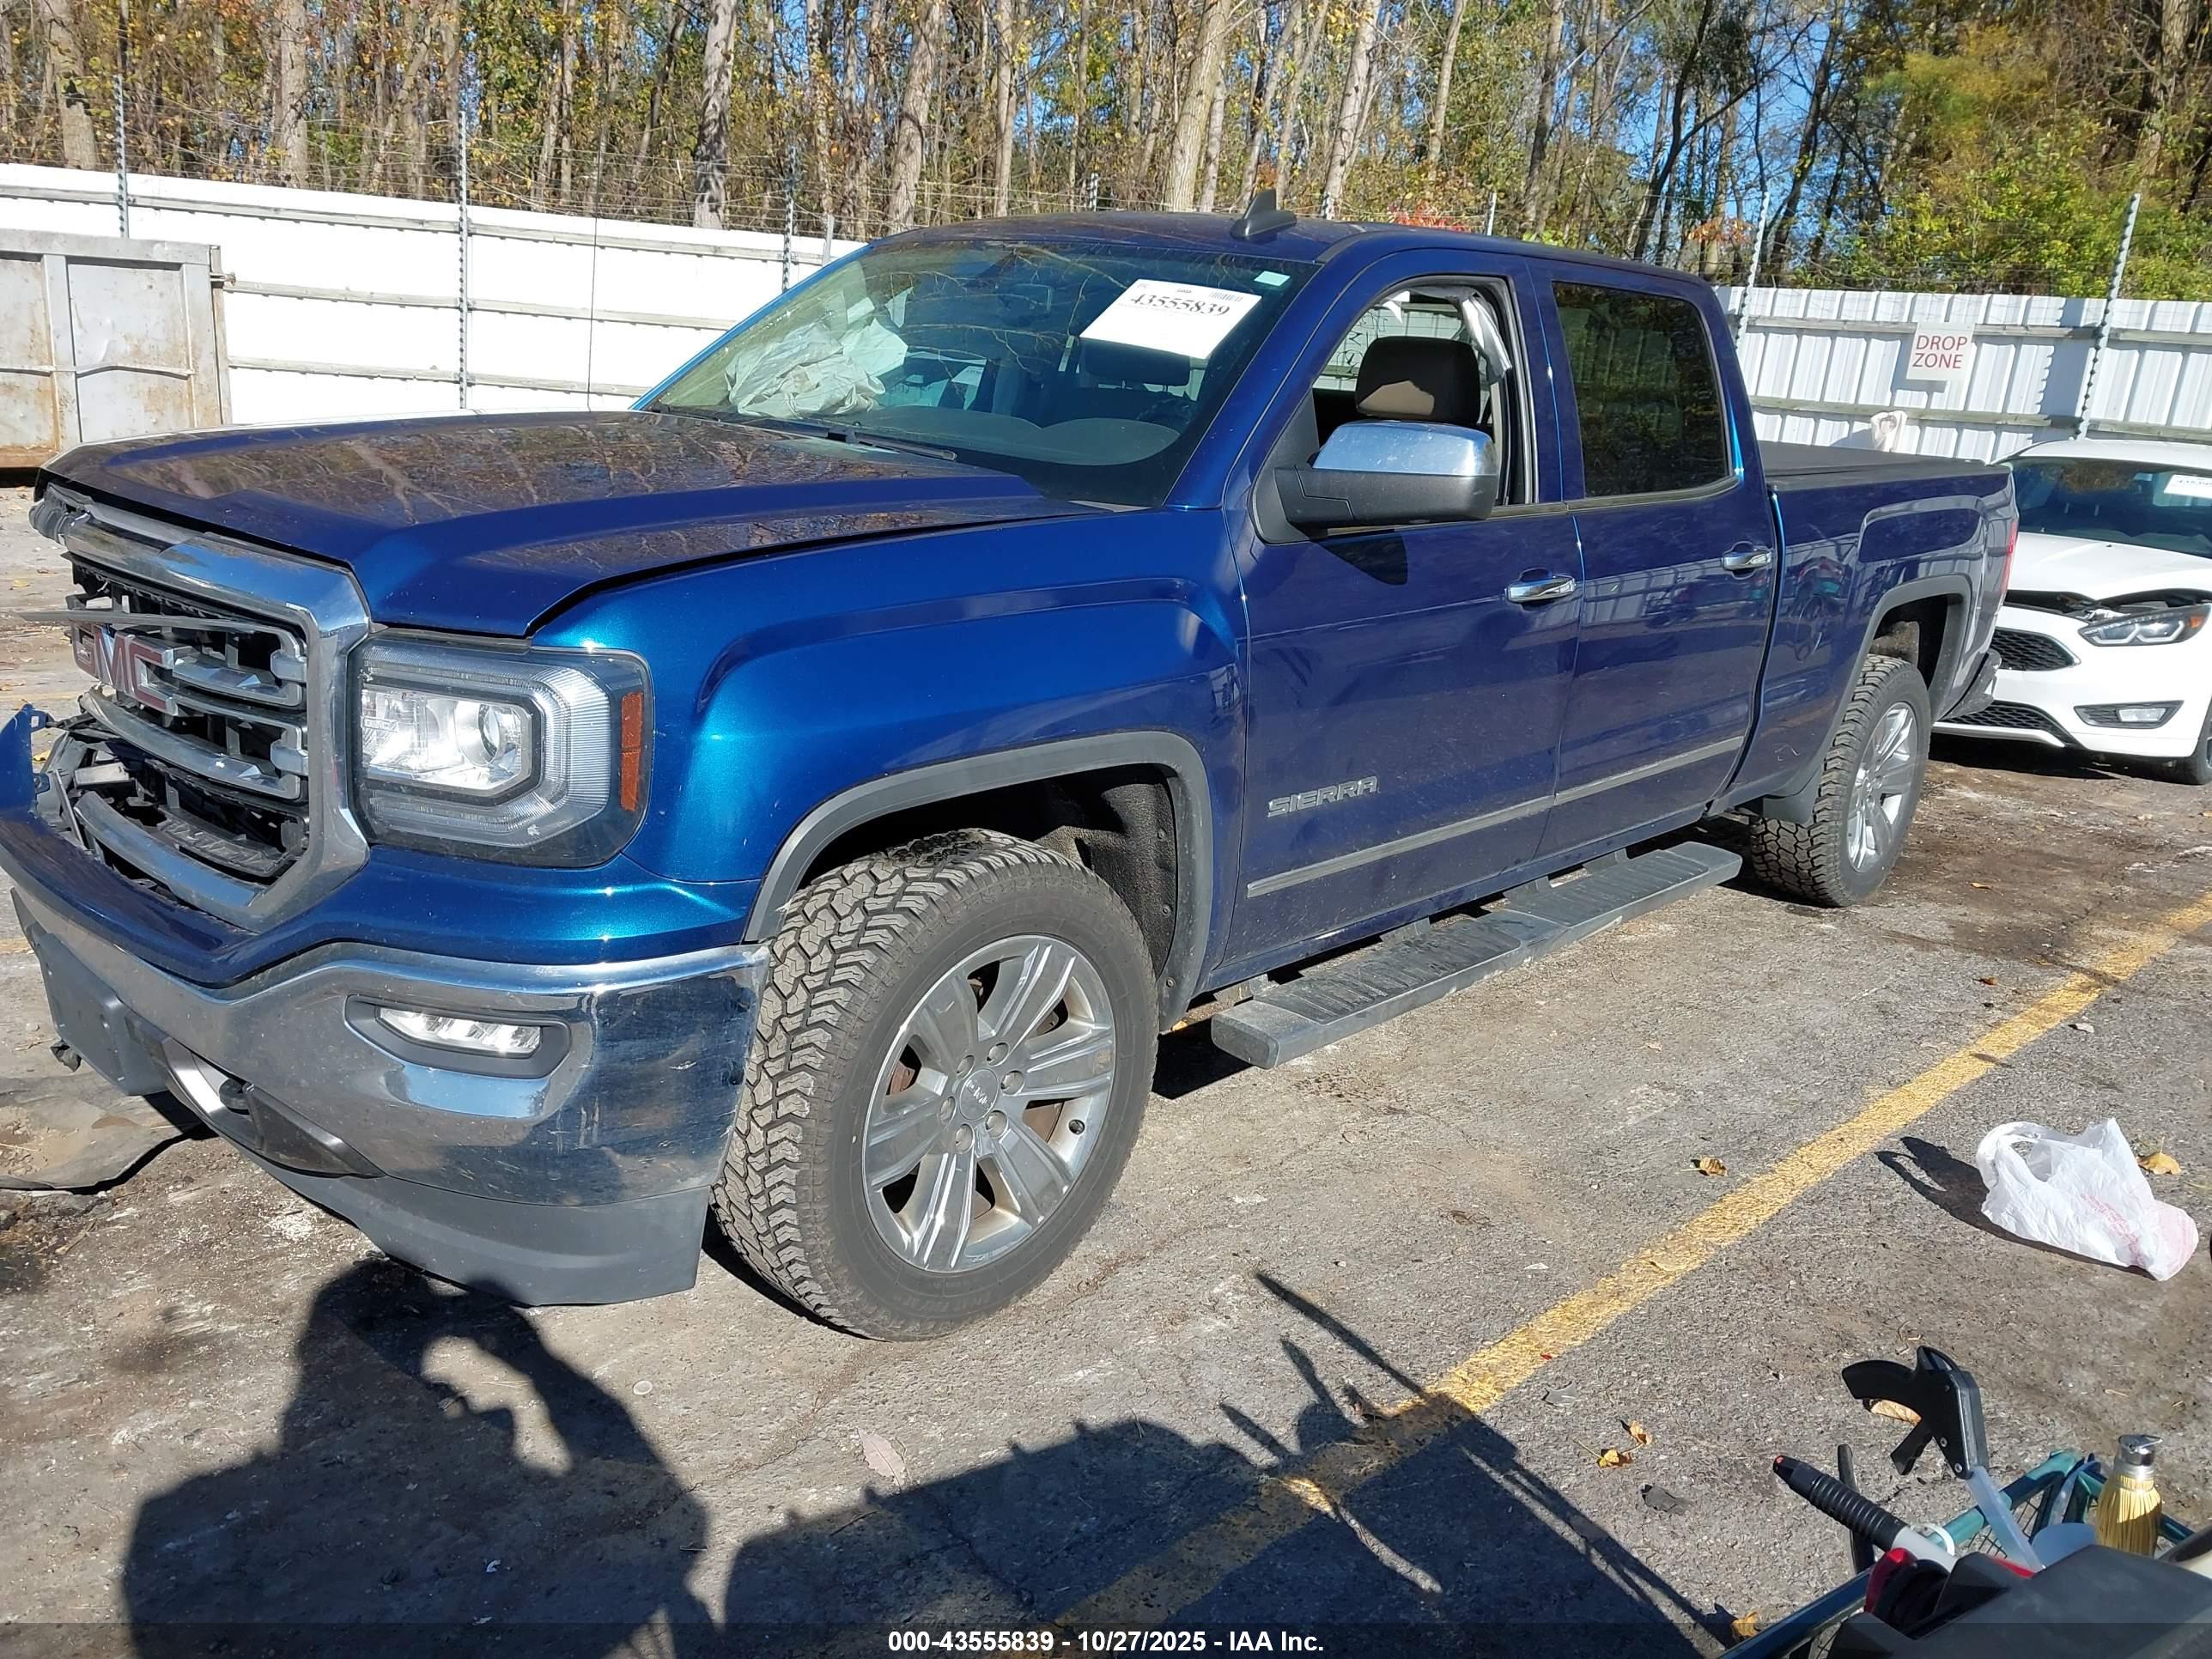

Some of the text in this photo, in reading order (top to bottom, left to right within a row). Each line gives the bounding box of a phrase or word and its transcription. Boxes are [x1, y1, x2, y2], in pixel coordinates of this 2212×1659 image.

[1130, 294, 1231, 317] 43555839
[1916, 335, 1968, 351] DROP
[1912, 353, 1964, 369] ZONE
[72, 622, 178, 716] GMC
[1267, 775, 1381, 818] SIERRA
